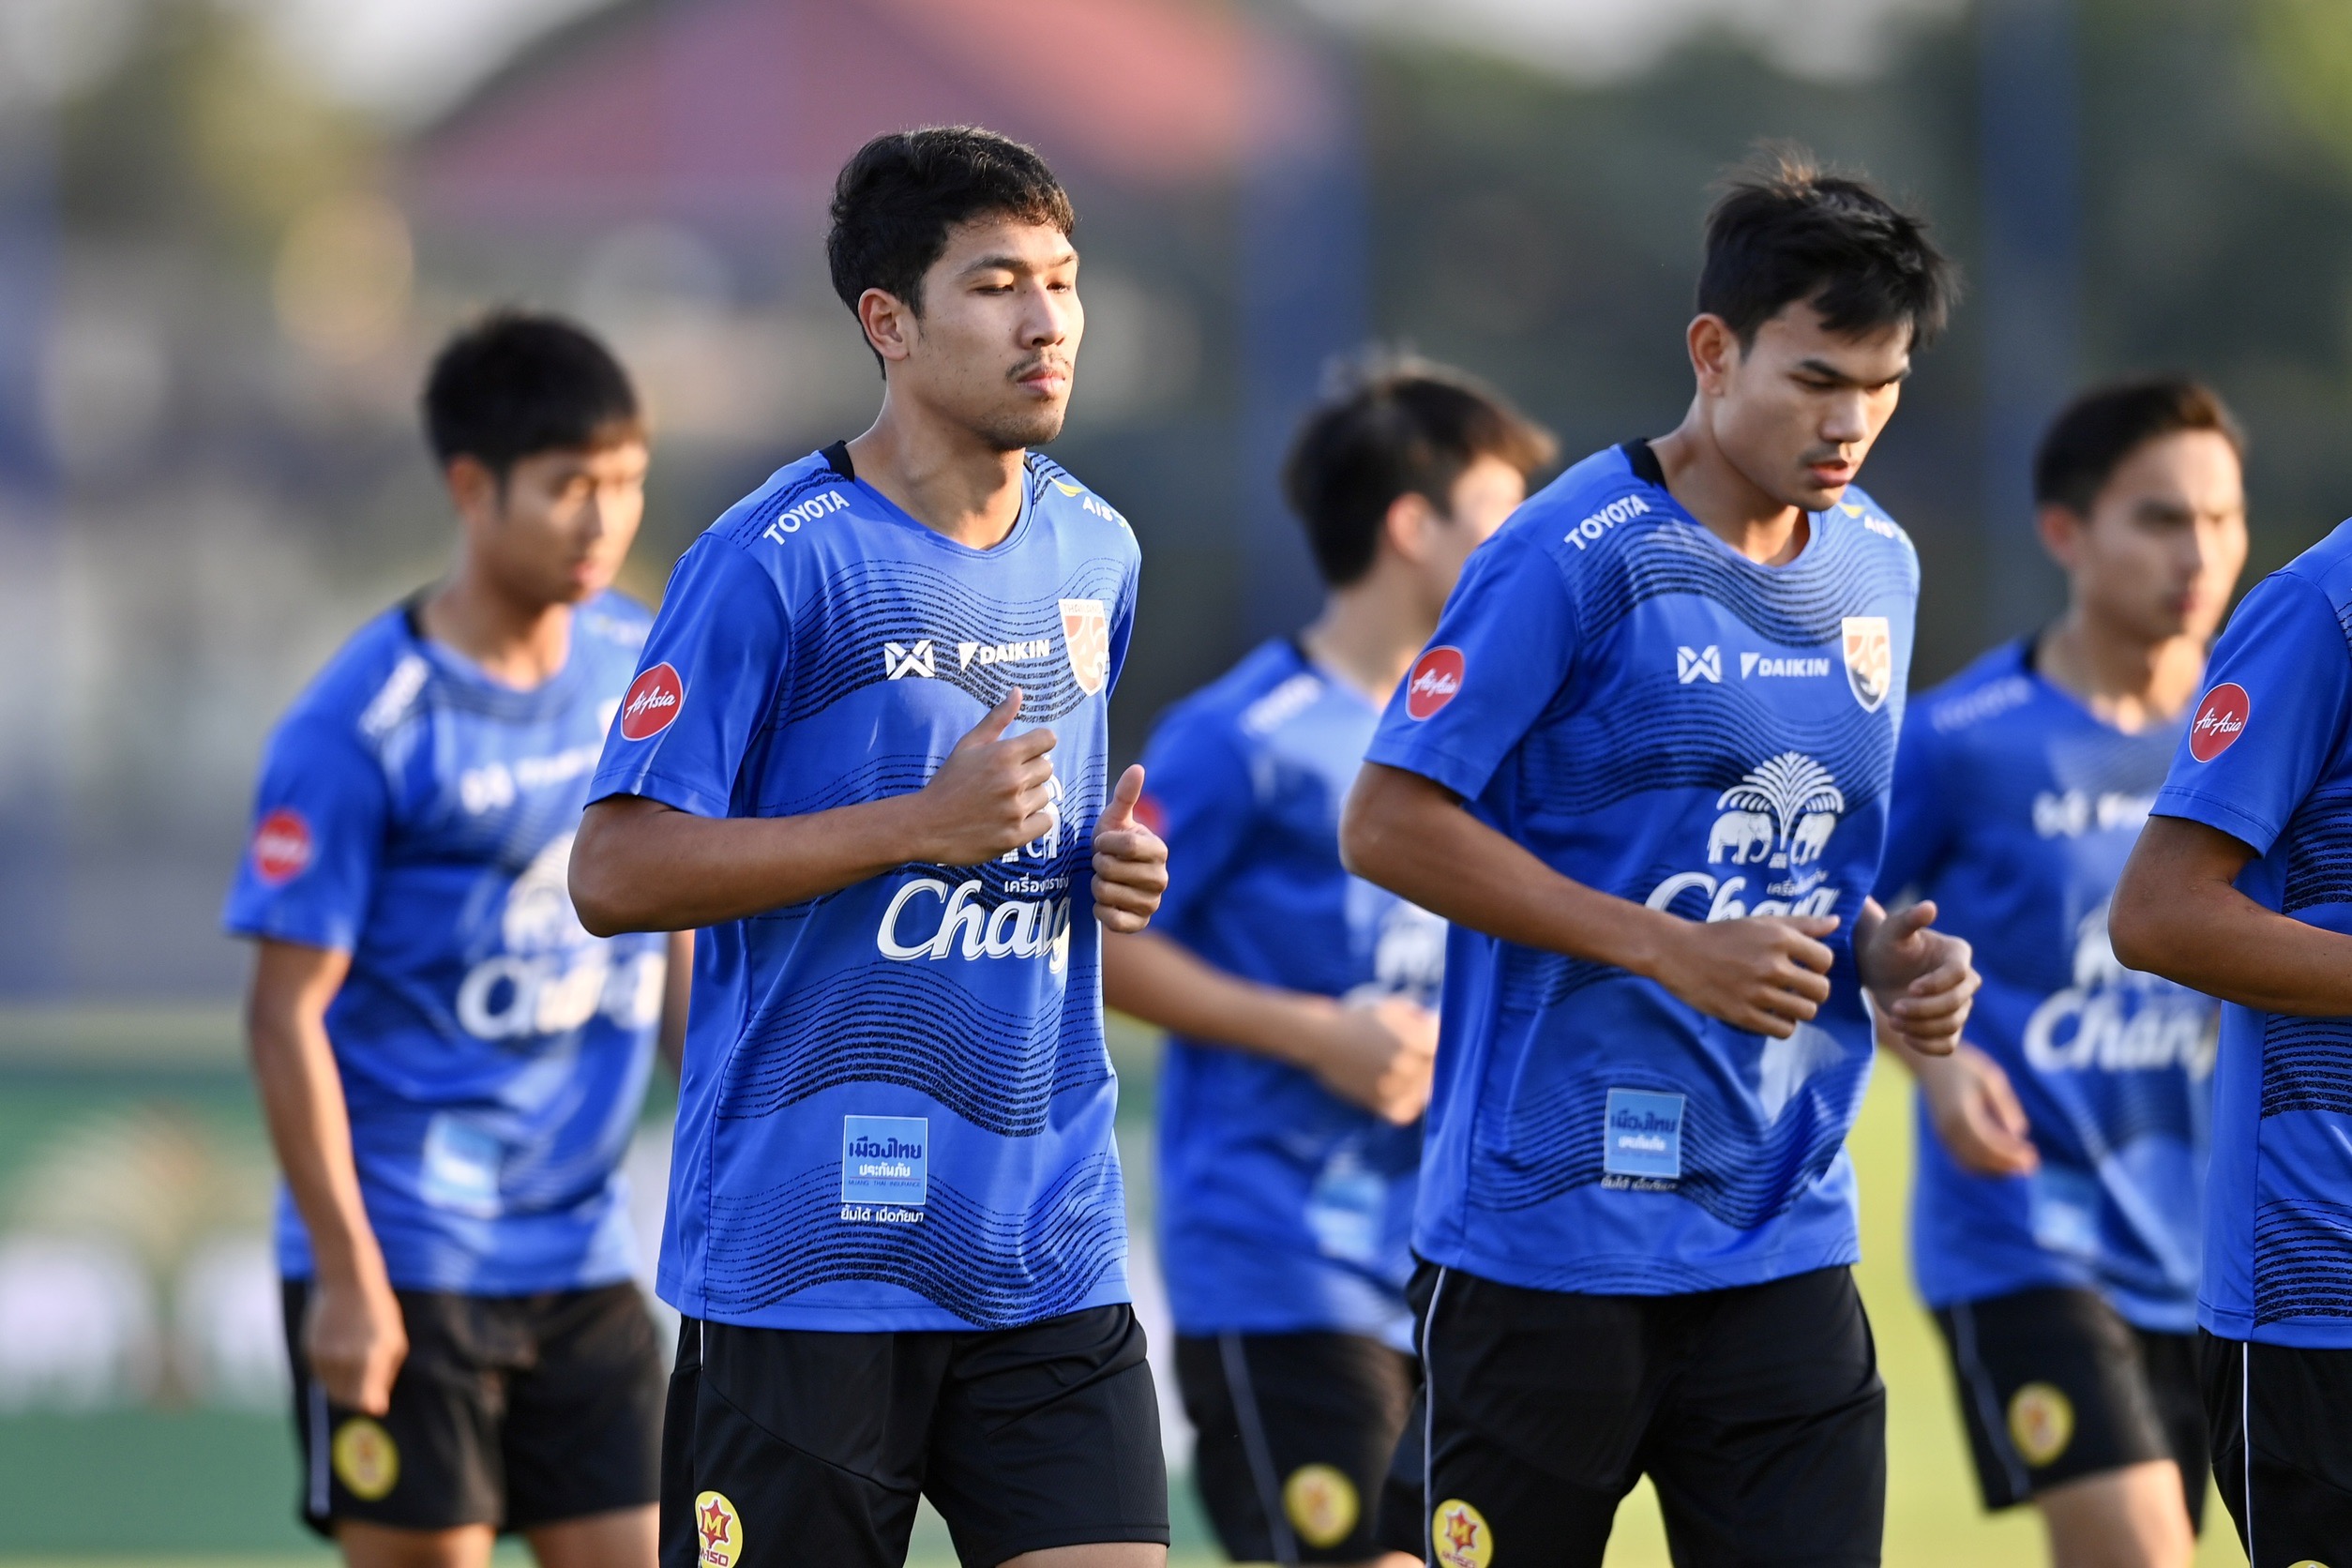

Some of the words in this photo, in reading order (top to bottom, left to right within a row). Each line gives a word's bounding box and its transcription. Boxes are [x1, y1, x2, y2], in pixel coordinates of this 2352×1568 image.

[762, 490, 851, 546] TOYOTA
[1563, 493, 1651, 550] TOYOTA
[980, 639, 1050, 665] DAIKIN
[1757, 657, 1830, 677] DAIKIN
[849, 1135, 922, 1160] เมืองไทย
[859, 1161, 911, 1178] ประกันภัย
[840, 1203, 871, 1221] ยิ้มได้
[876, 1205, 924, 1223] เมื่อภัยมา
[702, 1510, 725, 1538] M
